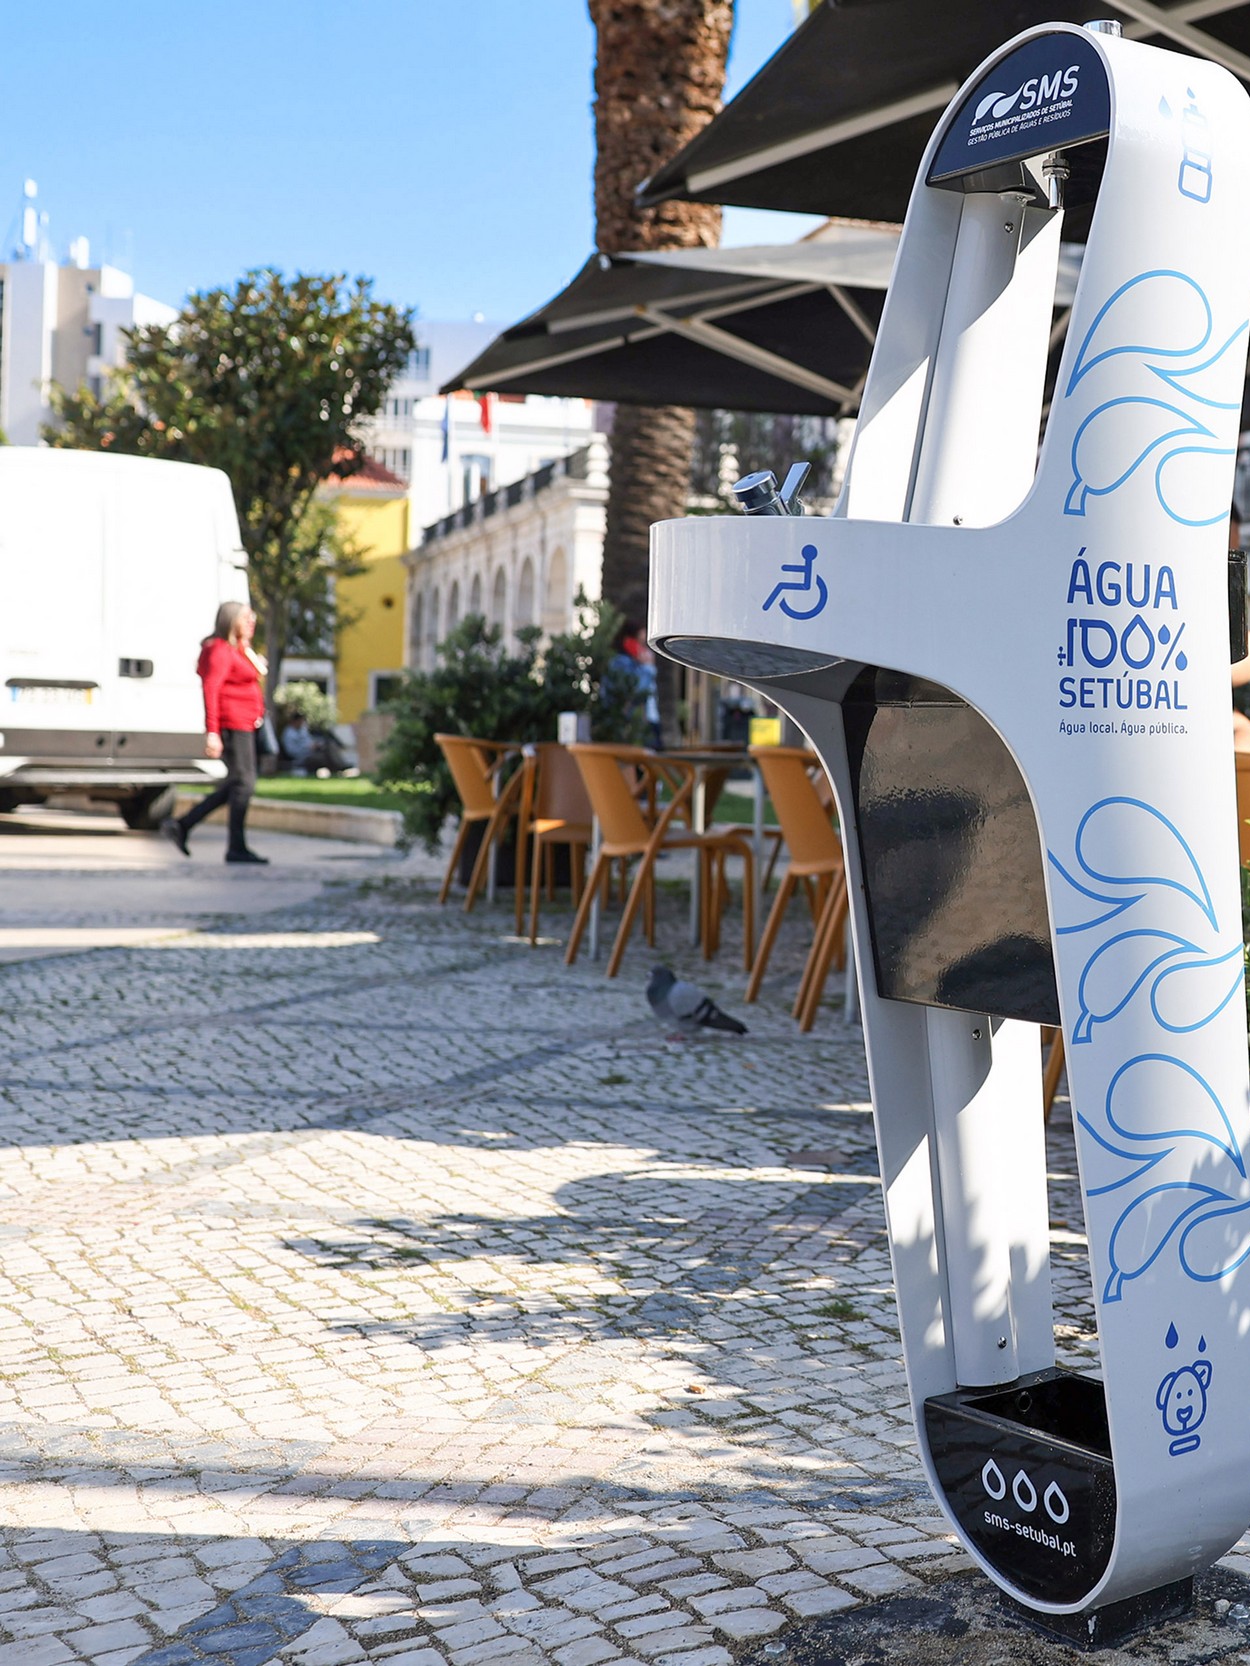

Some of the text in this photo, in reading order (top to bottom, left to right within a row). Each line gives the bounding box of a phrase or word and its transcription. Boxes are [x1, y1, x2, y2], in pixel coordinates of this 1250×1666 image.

[1019, 65, 1080, 110] SMS
[967, 134, 988, 146] GESTÃO
[988, 128, 1011, 141] PÚBLICA
[1011, 125, 1018, 134] DE
[1019, 120, 1038, 131] ÁGUAS
[1043, 109, 1071, 123] RESÍDUOS
[969, 99, 1073, 137] SERVIÇOS MUNICIPALIZADOS DE SETÚBAL
[1066, 547, 1178, 610] ÁGUA
[1059, 671, 1188, 710] SETÚBAL
[1059, 719, 1188, 736] Água local. Água pública.
[984, 1511, 1077, 1557] sms-setubal.pt
